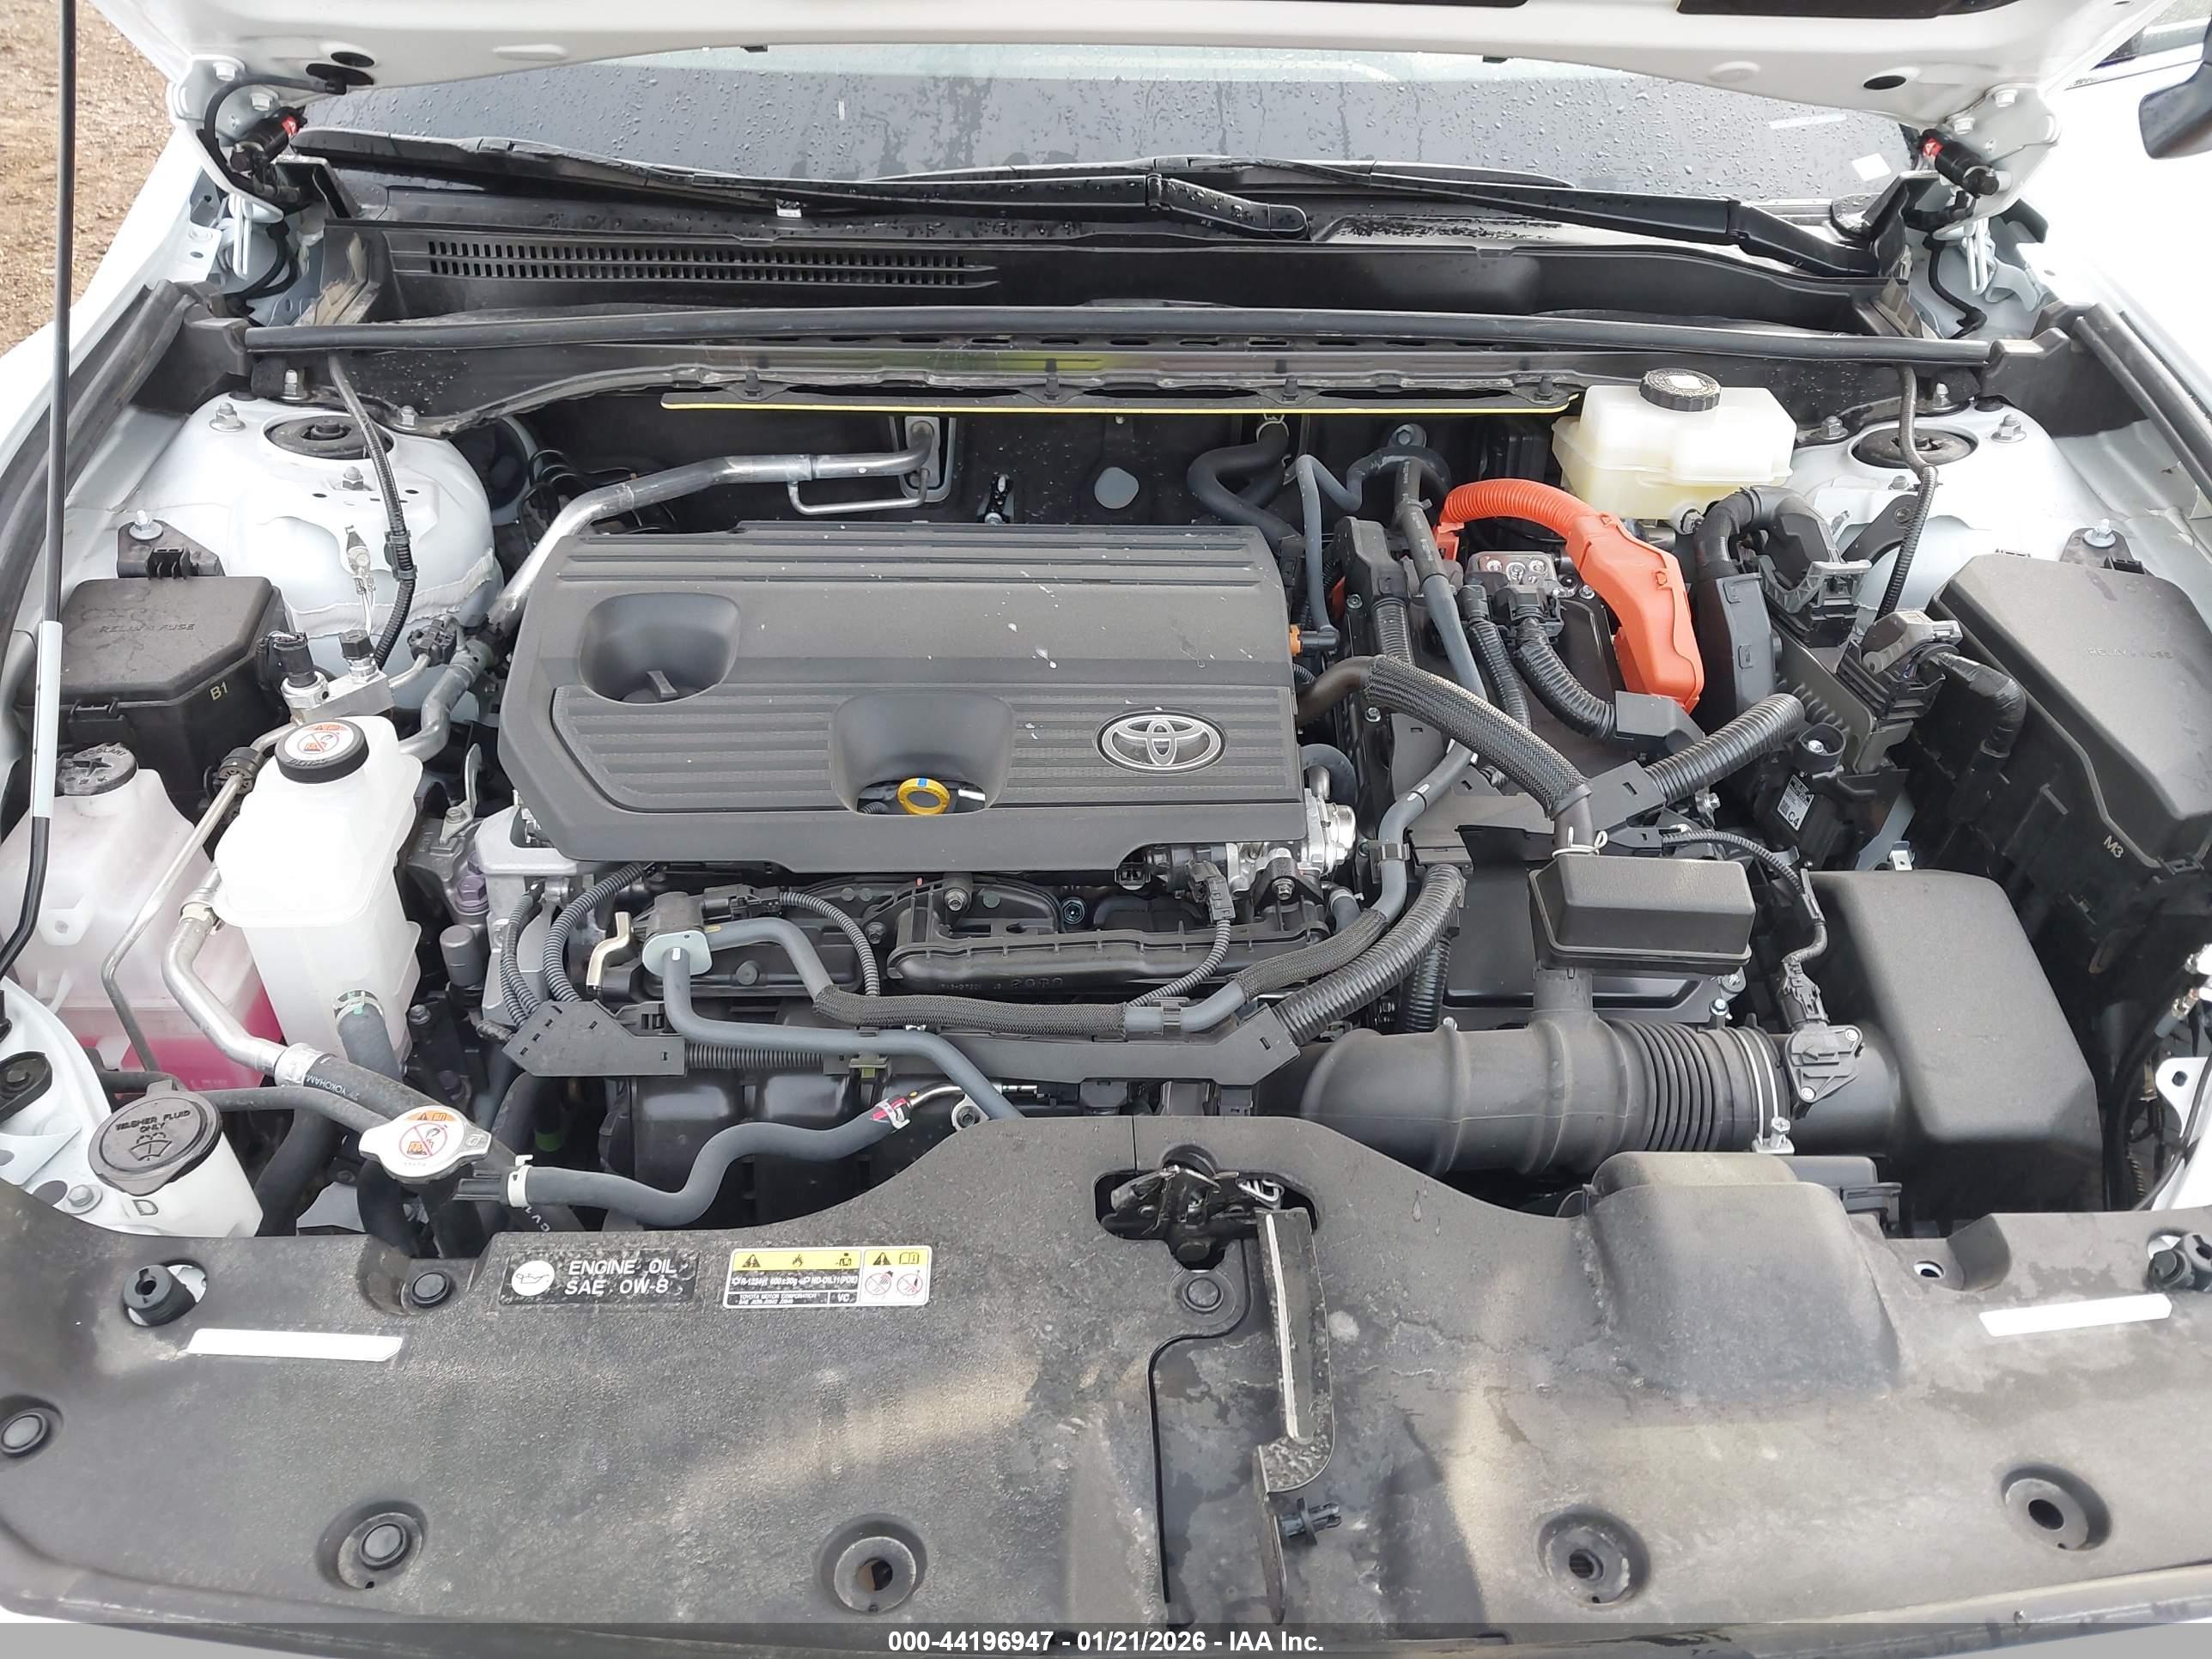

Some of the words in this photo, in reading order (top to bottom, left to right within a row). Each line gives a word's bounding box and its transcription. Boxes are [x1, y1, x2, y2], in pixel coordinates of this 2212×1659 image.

[210, 681, 228, 701] B1
[82, 748, 127, 757] COOLANT
[1788, 811, 1801, 828] C4
[2104, 835, 2124, 858] M3
[116, 1116, 157, 1131] WASHER
[163, 1110, 191, 1121] FLUID
[139, 1122, 166, 1133] ONLY
[568, 1259, 637, 1275] ENGINE
[648, 1259, 677, 1274] OIL
[564, 1279, 606, 1295] SAE
[837, 1292, 850, 1303] VC
